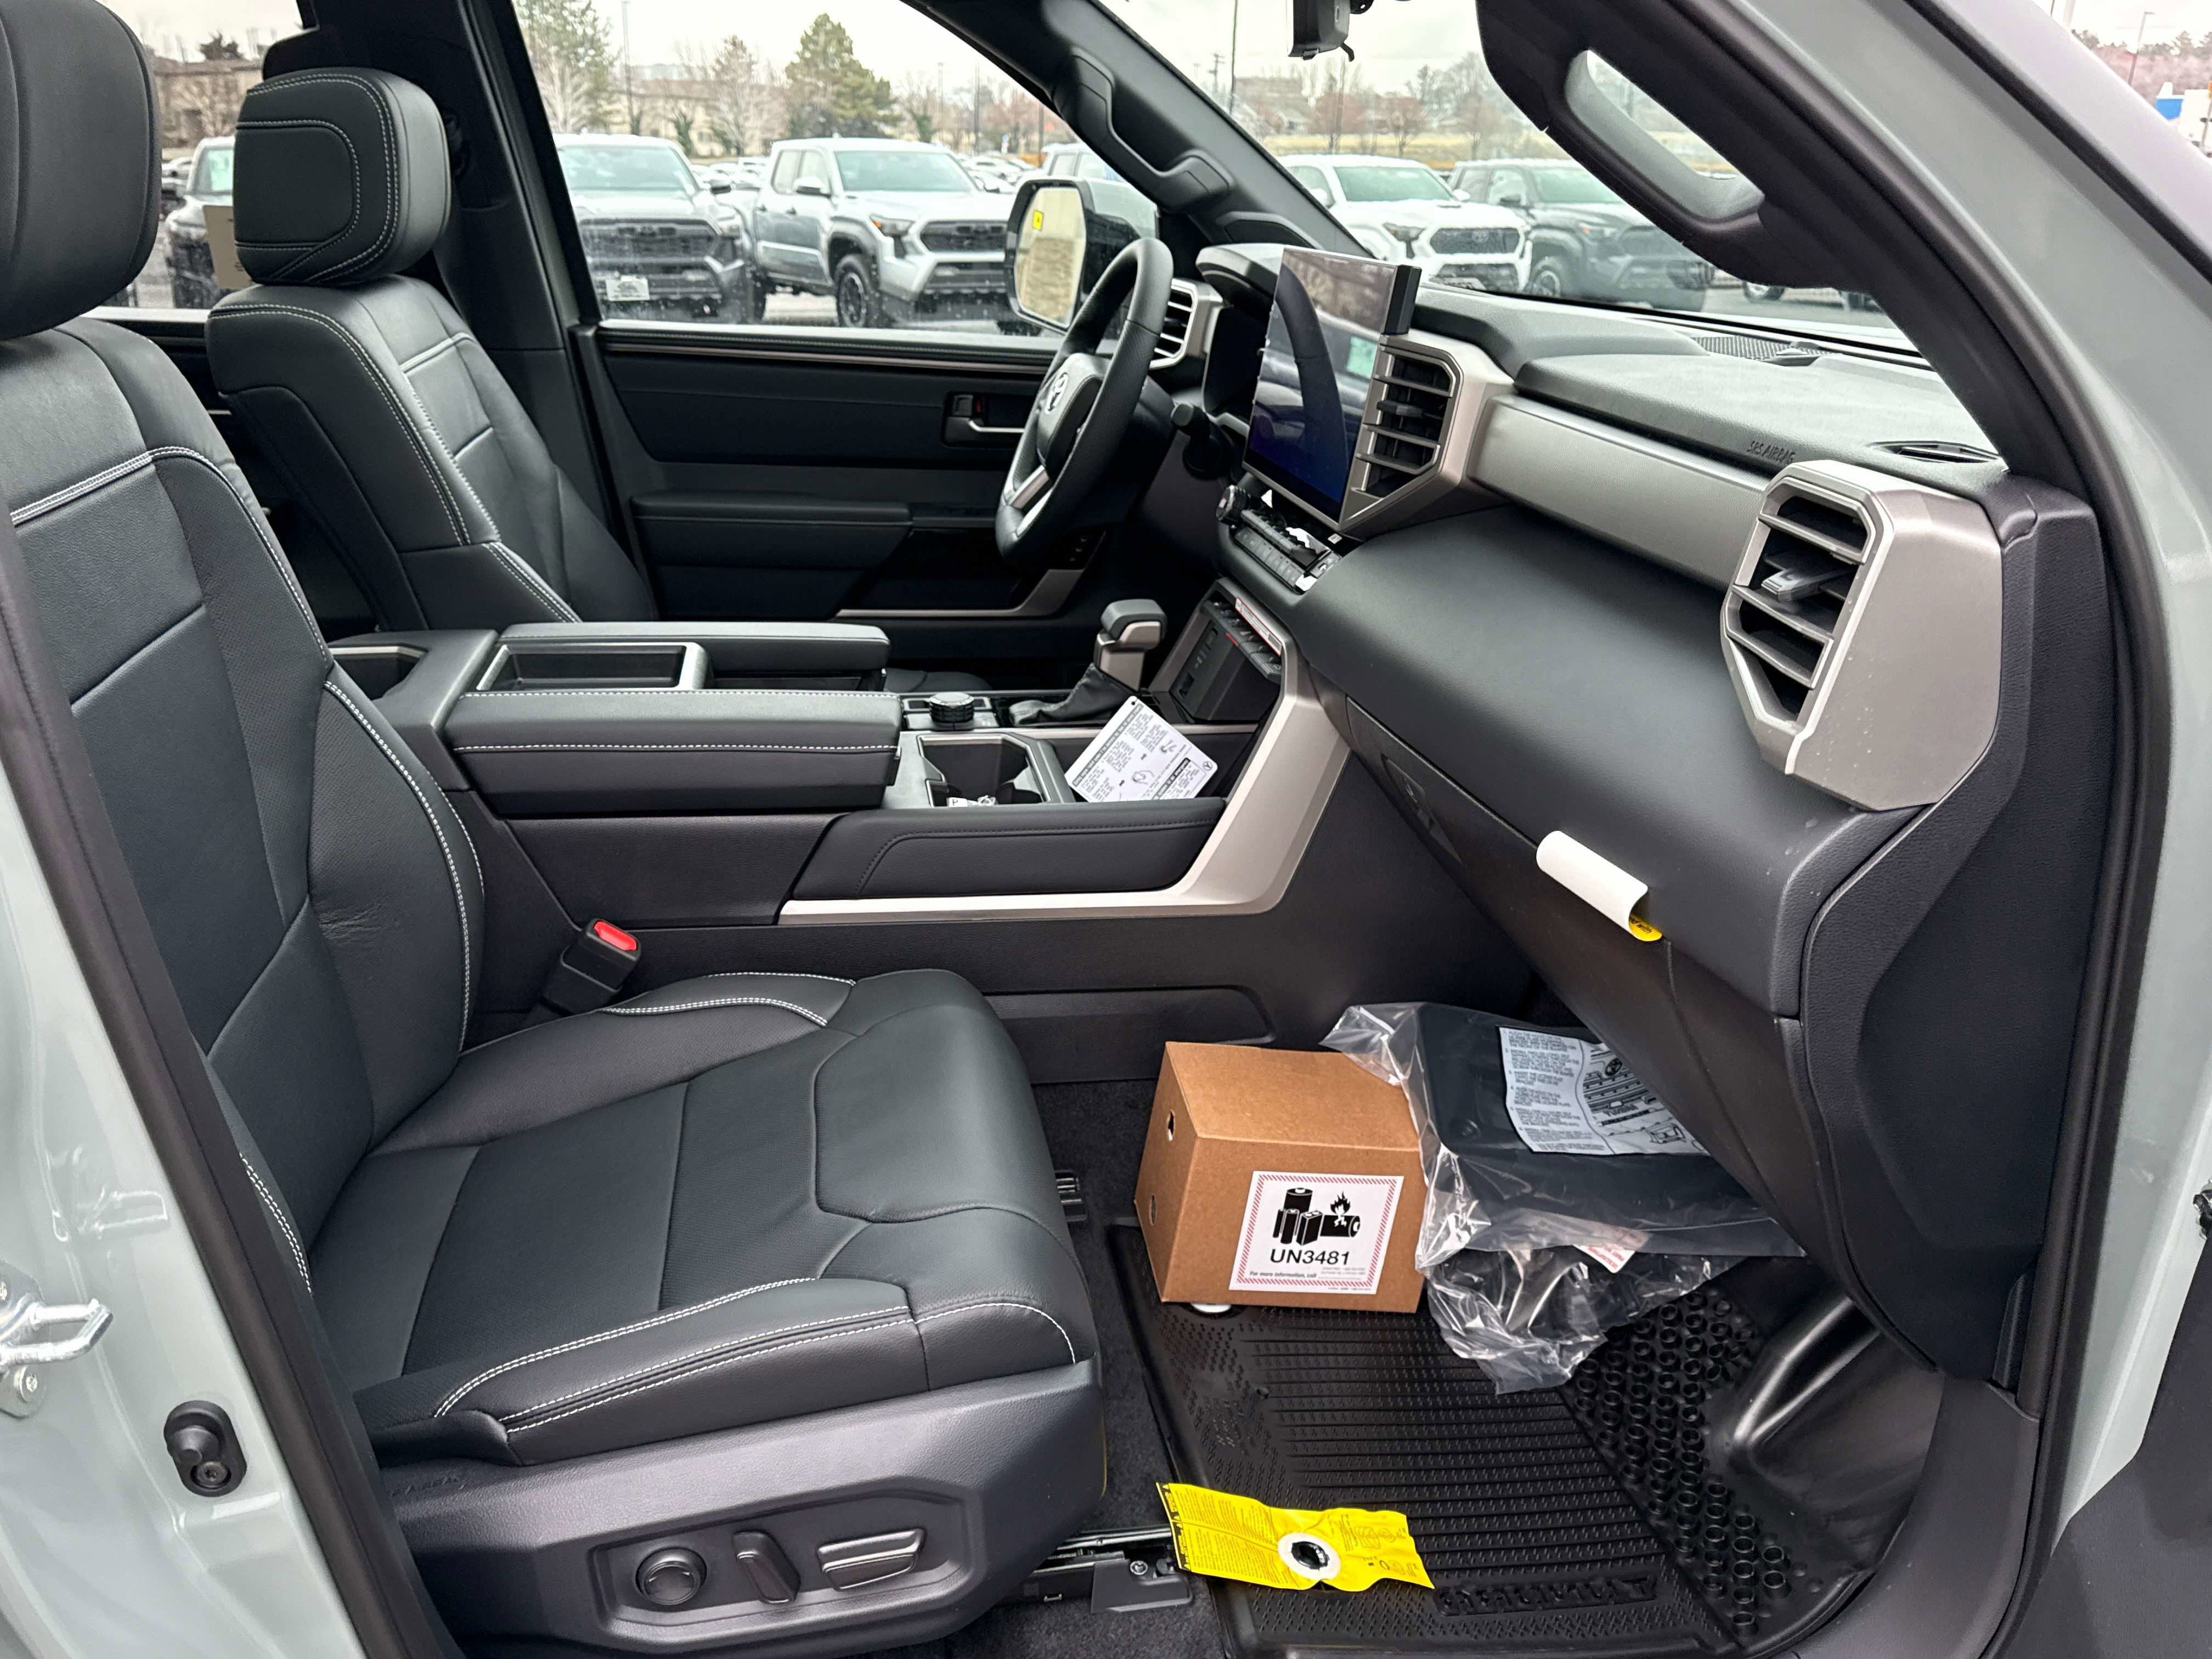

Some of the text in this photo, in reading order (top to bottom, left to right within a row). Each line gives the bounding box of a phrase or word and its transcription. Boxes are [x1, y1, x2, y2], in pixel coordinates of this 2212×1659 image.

[1747, 441, 1796, 465] SRS AIRBAG
[1270, 1249, 1350, 1265] UN3481
